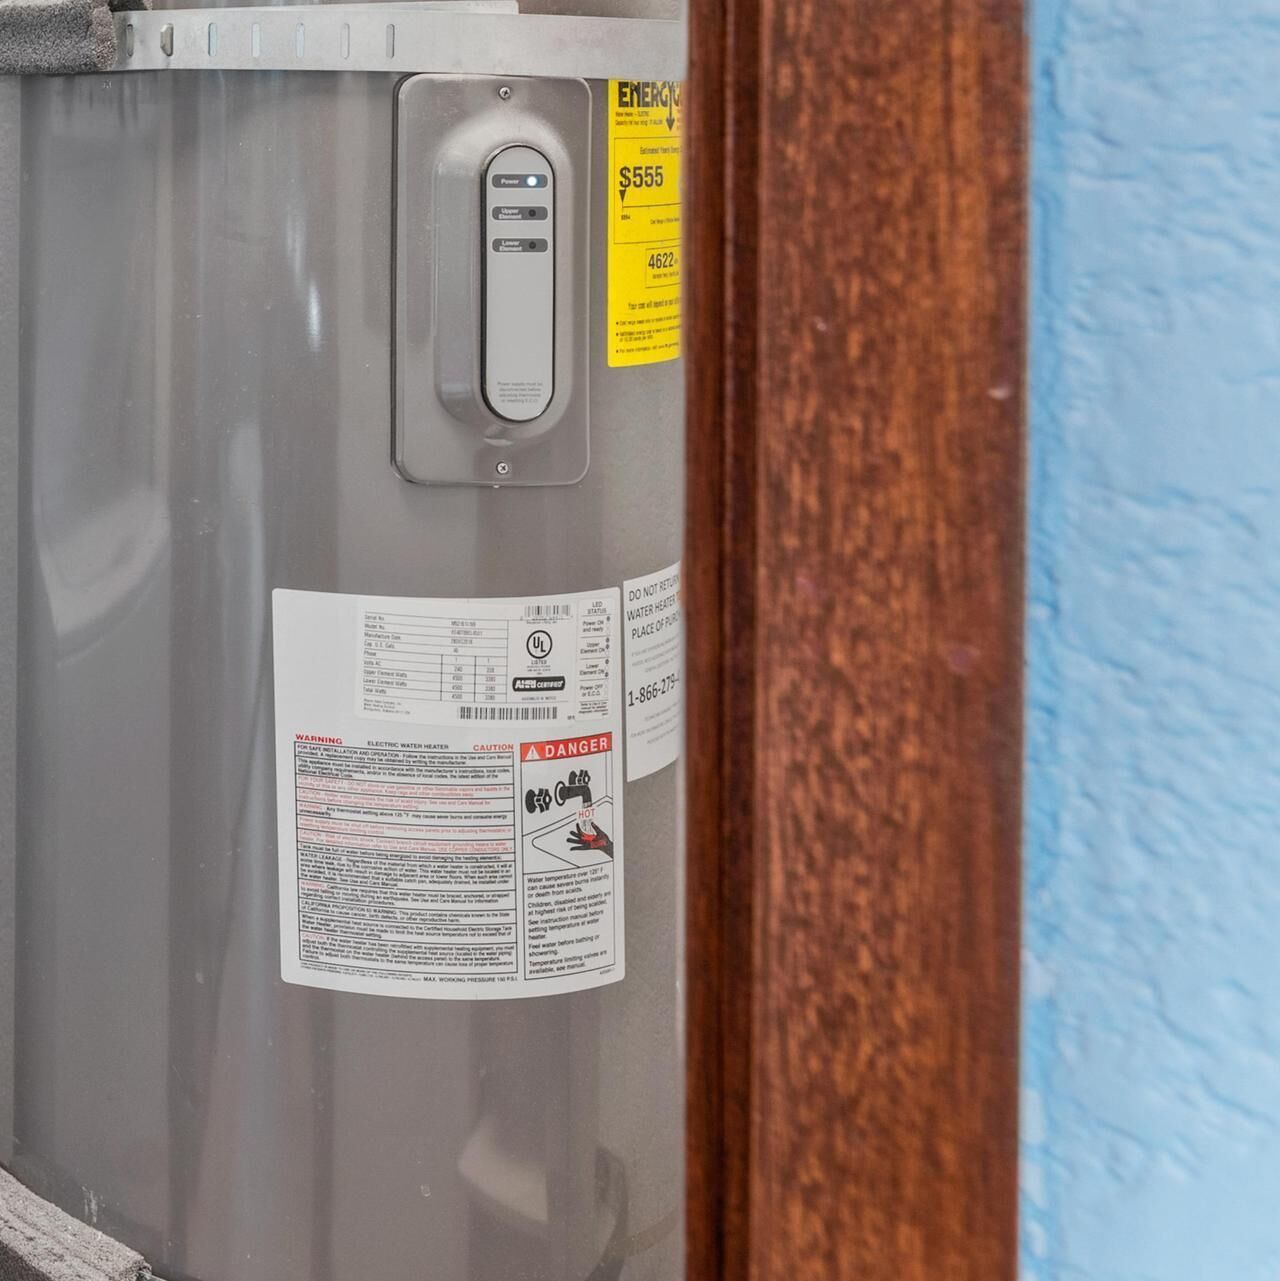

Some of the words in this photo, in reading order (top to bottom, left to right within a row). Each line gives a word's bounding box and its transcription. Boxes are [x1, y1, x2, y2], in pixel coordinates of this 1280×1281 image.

[619, 165, 664, 189] $555
[648, 252, 674, 269] 4622
[629, 589, 641, 602] DO
[643, 583, 658, 598] NOT
[627, 604, 653, 621] WATER
[655, 593, 675, 611] HEATER
[632, 622, 654, 639] PLACE
[655, 619, 665, 632] OF
[533, 636, 546, 652] UL
[296, 733, 342, 745] WARNING
[368, 740, 399, 748] ELECTRIC
[545, 737, 608, 758] DANGER
[578, 808, 595, 819] HOT
